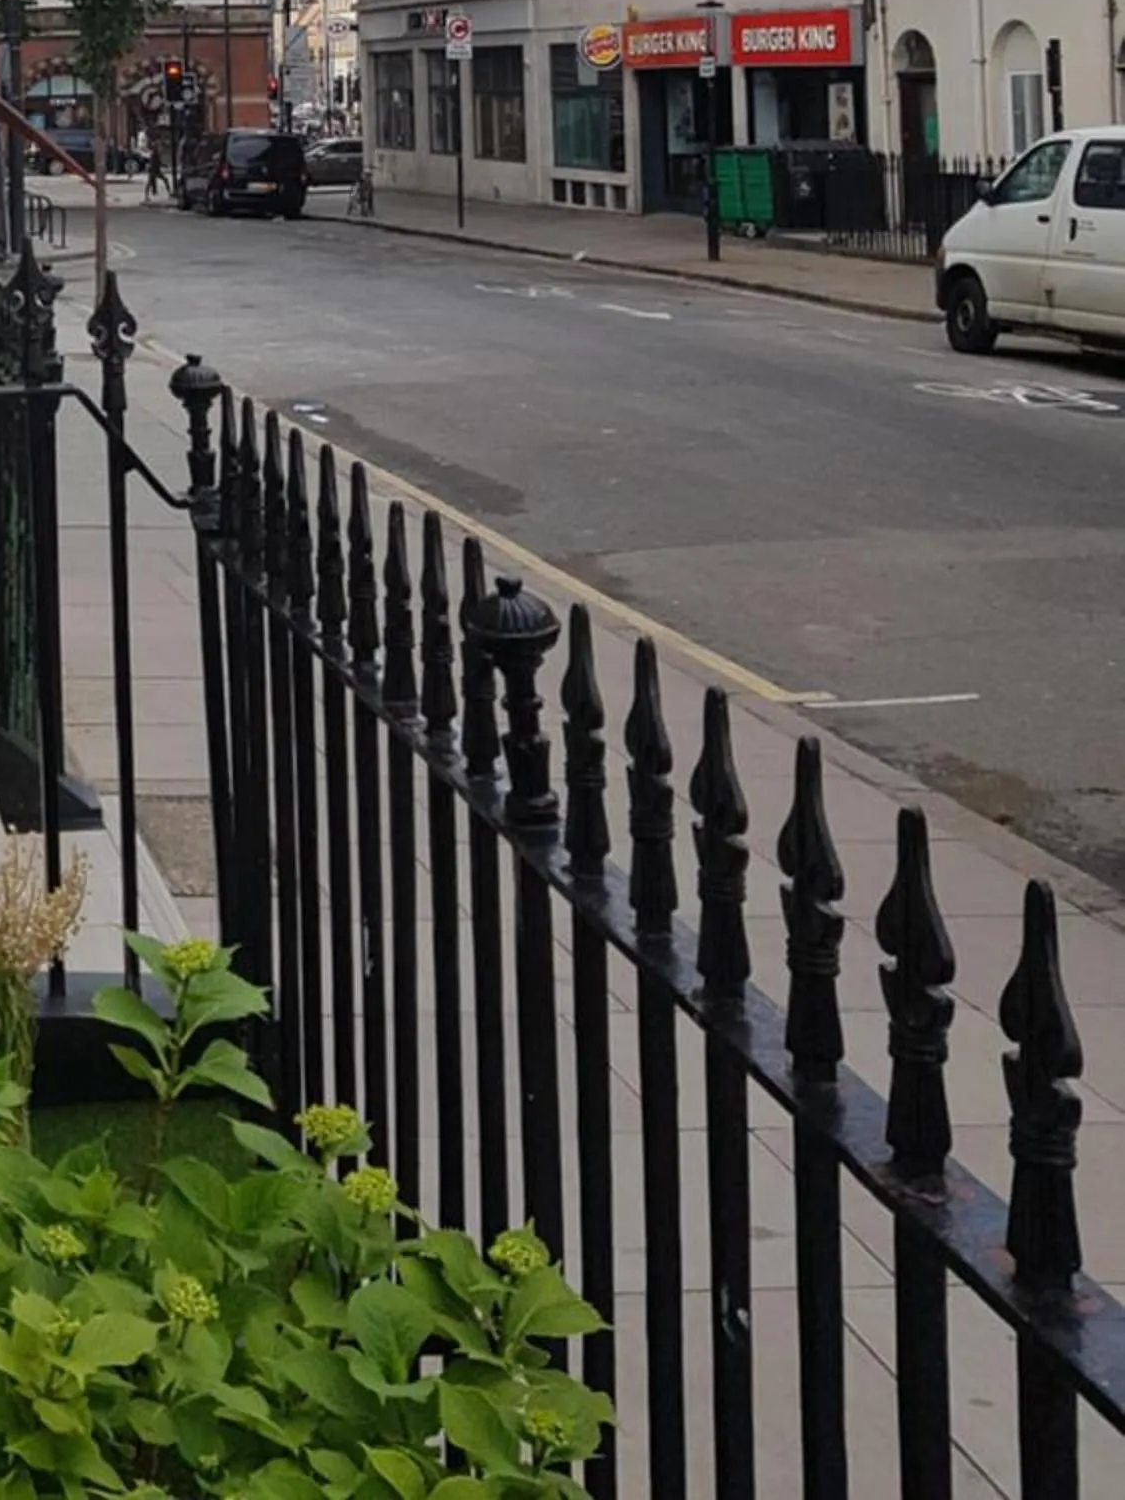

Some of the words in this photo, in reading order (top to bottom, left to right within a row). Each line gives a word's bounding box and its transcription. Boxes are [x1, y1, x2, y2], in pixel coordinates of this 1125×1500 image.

[628, 31, 674, 56] BURGER
[741, 25, 795, 53] BURGER
[797, 23, 836, 51] KING
